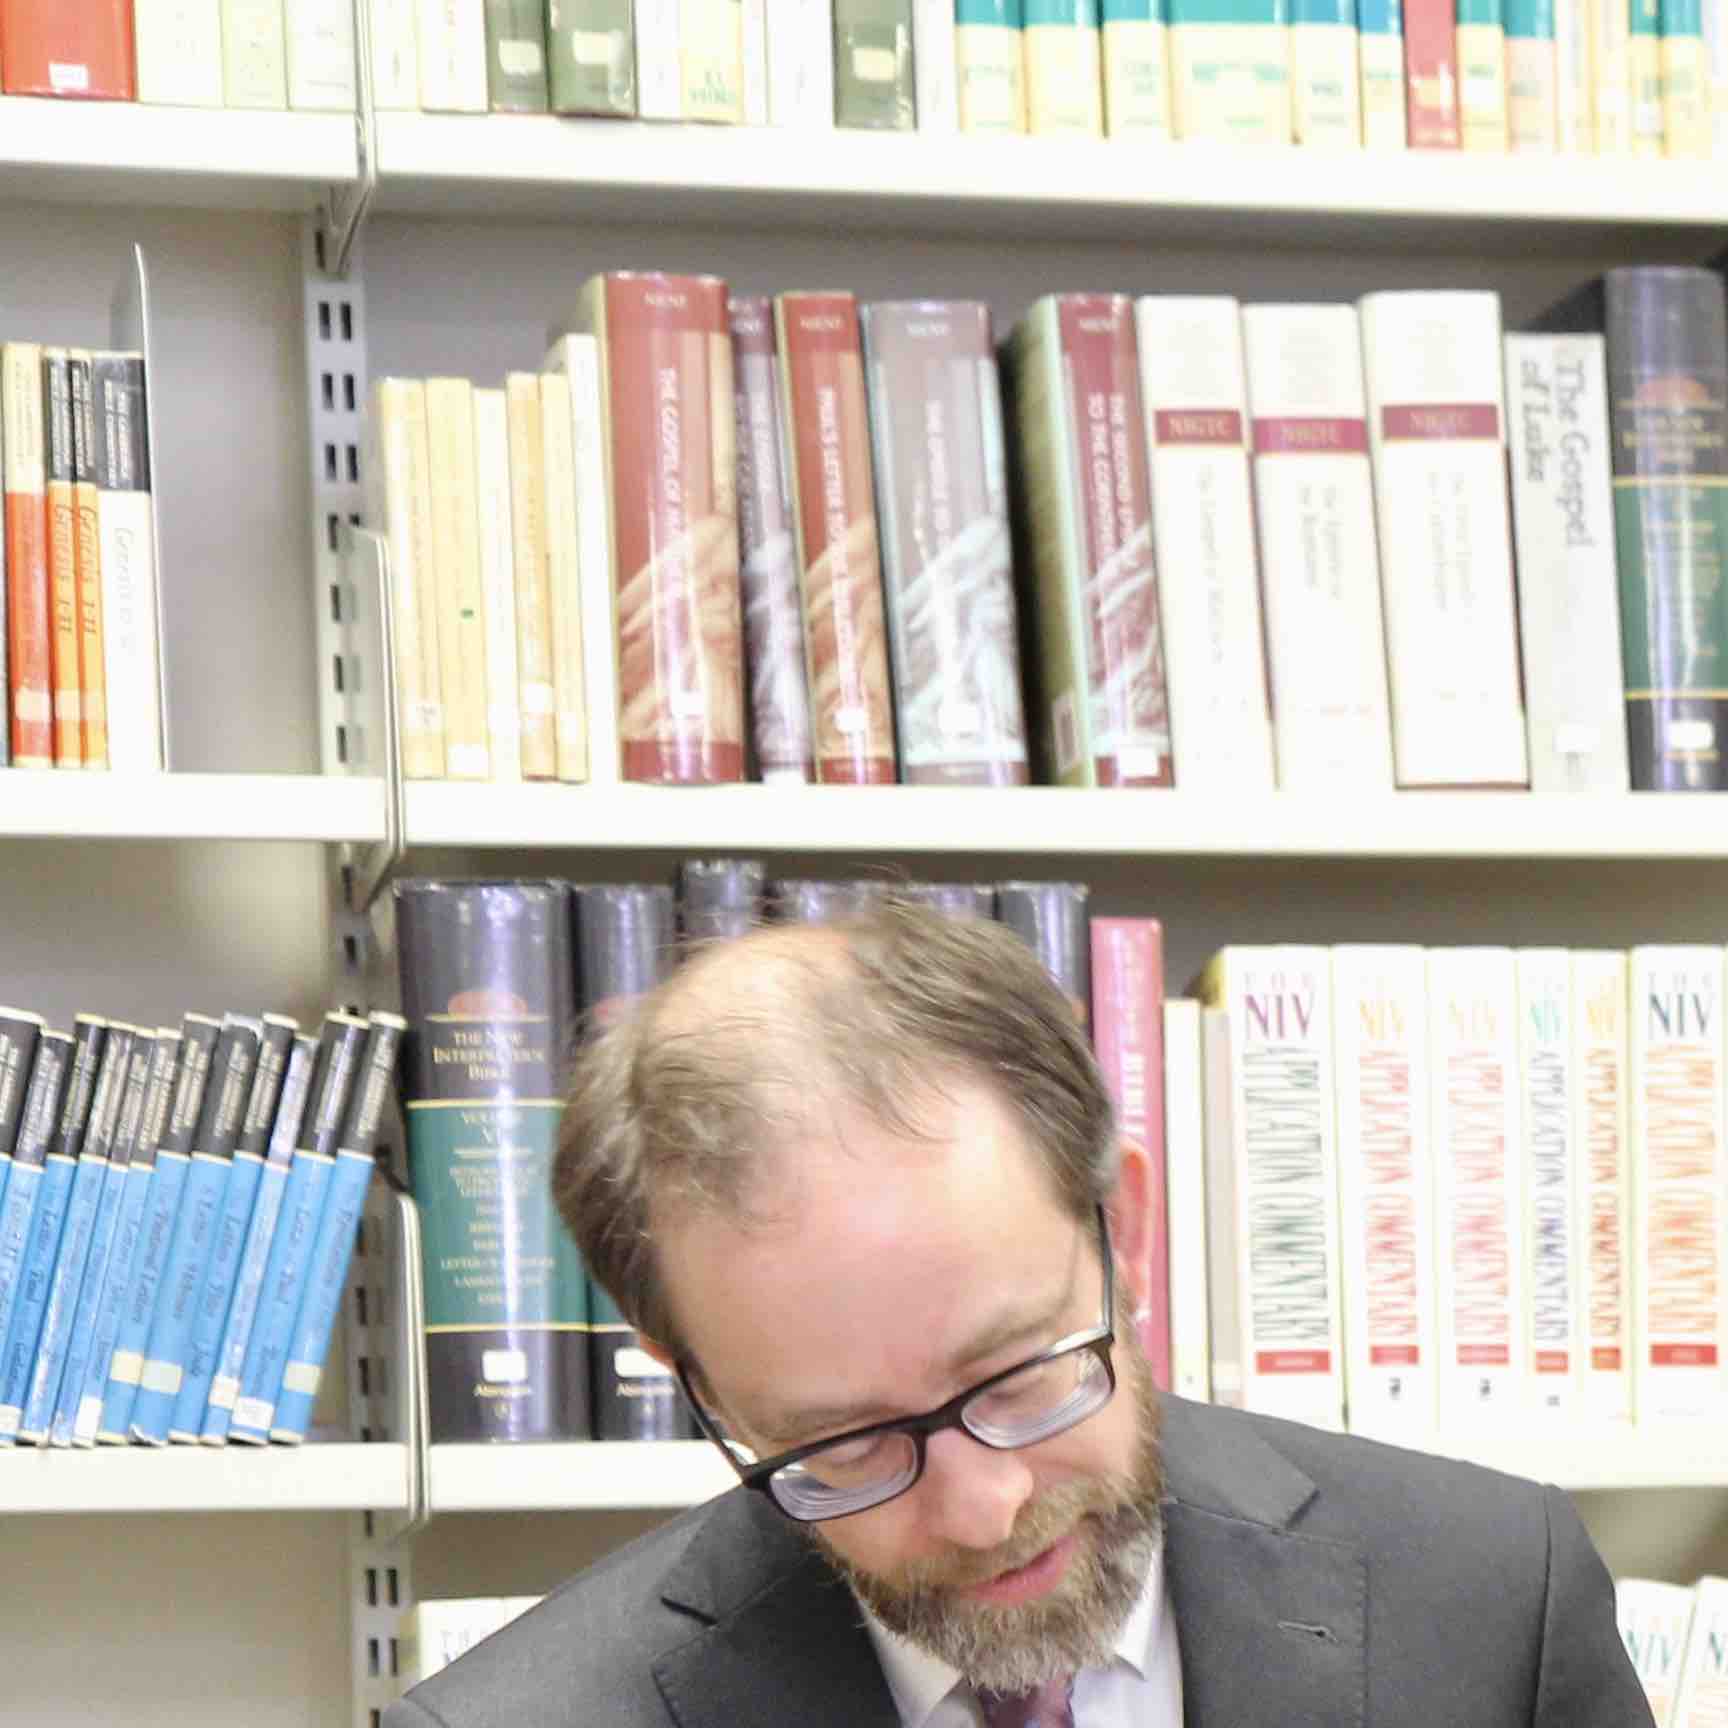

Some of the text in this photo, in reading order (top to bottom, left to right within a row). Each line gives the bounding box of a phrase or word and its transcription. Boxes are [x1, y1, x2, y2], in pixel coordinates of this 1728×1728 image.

[1519, 357, 1556, 484] of Luke
[1547, 360, 1599, 553] The Gospel
[53, 502, 73, 581] Genesis
[77, 502, 99, 581] Genesis
[453, 1030, 487, 1047] THE
[1242, 993, 1315, 1040] NIV
[1647, 992, 1714, 1039] NIV
[1241, 1046, 1323, 1185] APPLICATION
[1530, 1049, 1568, 1188] APPLICATION
[1245, 1191, 1329, 1342] COMMENTARY
[1532, 1194, 1569, 1342] COMMENTARY
